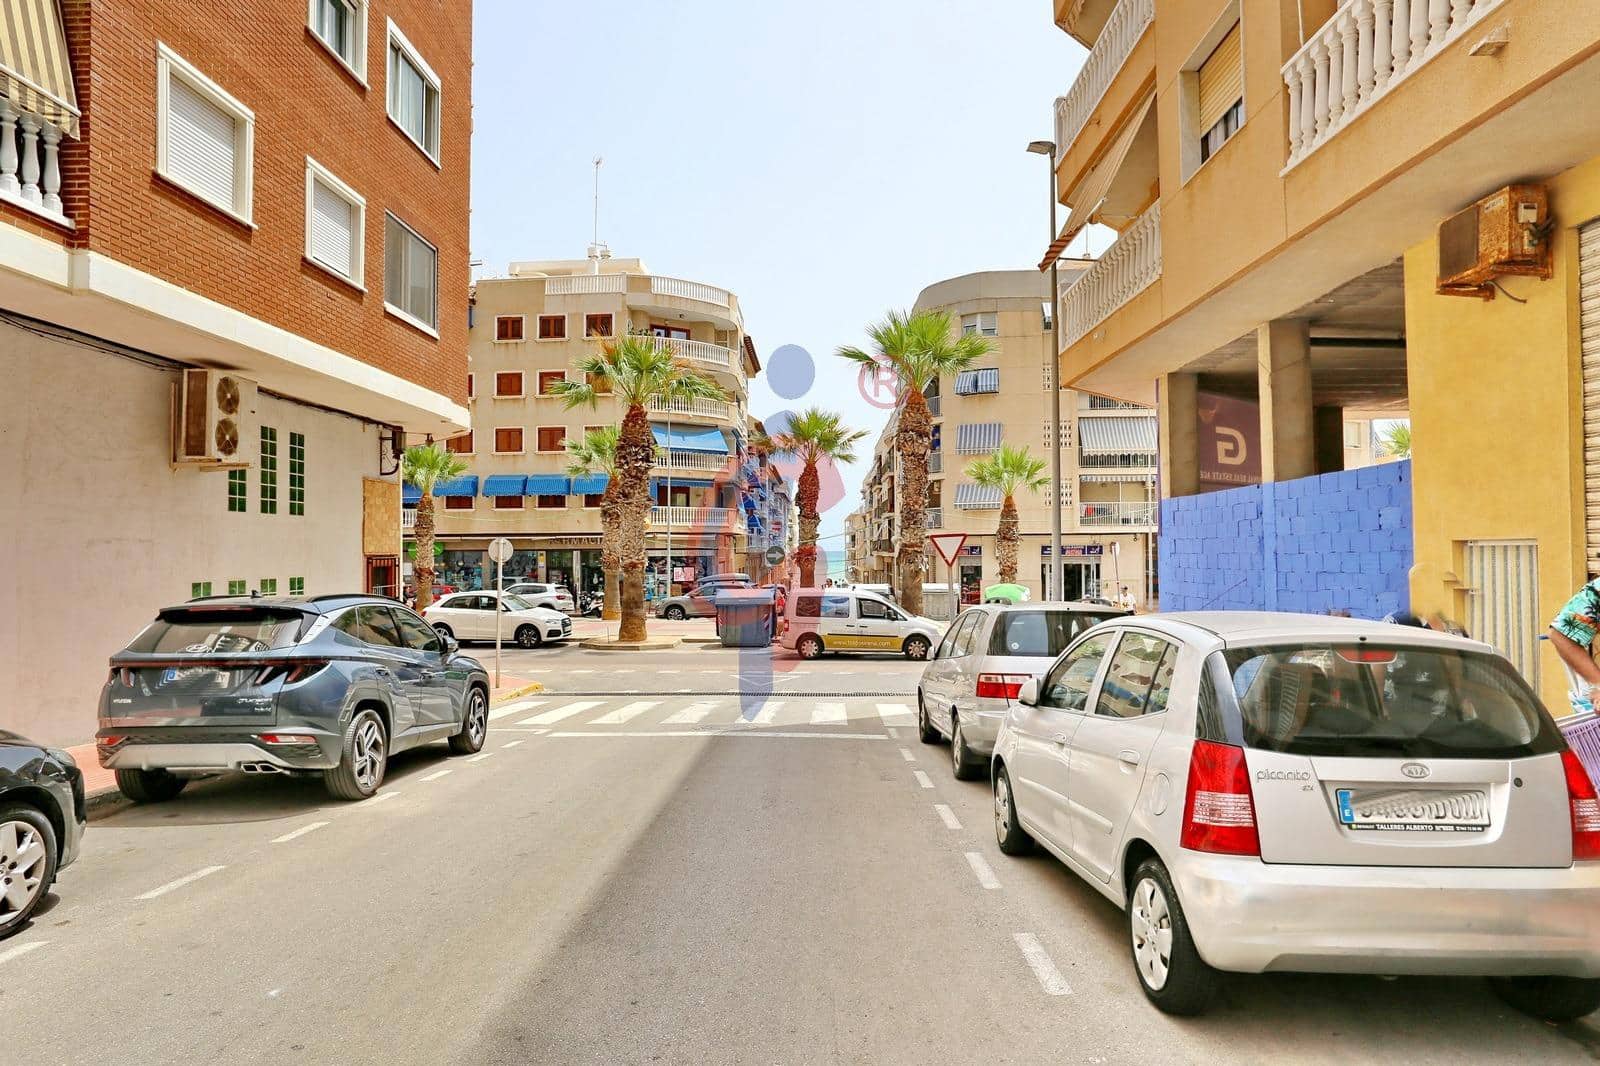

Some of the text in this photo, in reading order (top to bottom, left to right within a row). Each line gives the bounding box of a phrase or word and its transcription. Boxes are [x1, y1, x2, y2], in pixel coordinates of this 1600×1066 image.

[1256, 769, 1311, 783] picanto
[1375, 823, 1405, 831] TALLERES
[1405, 824, 1434, 832] ALBERTO
